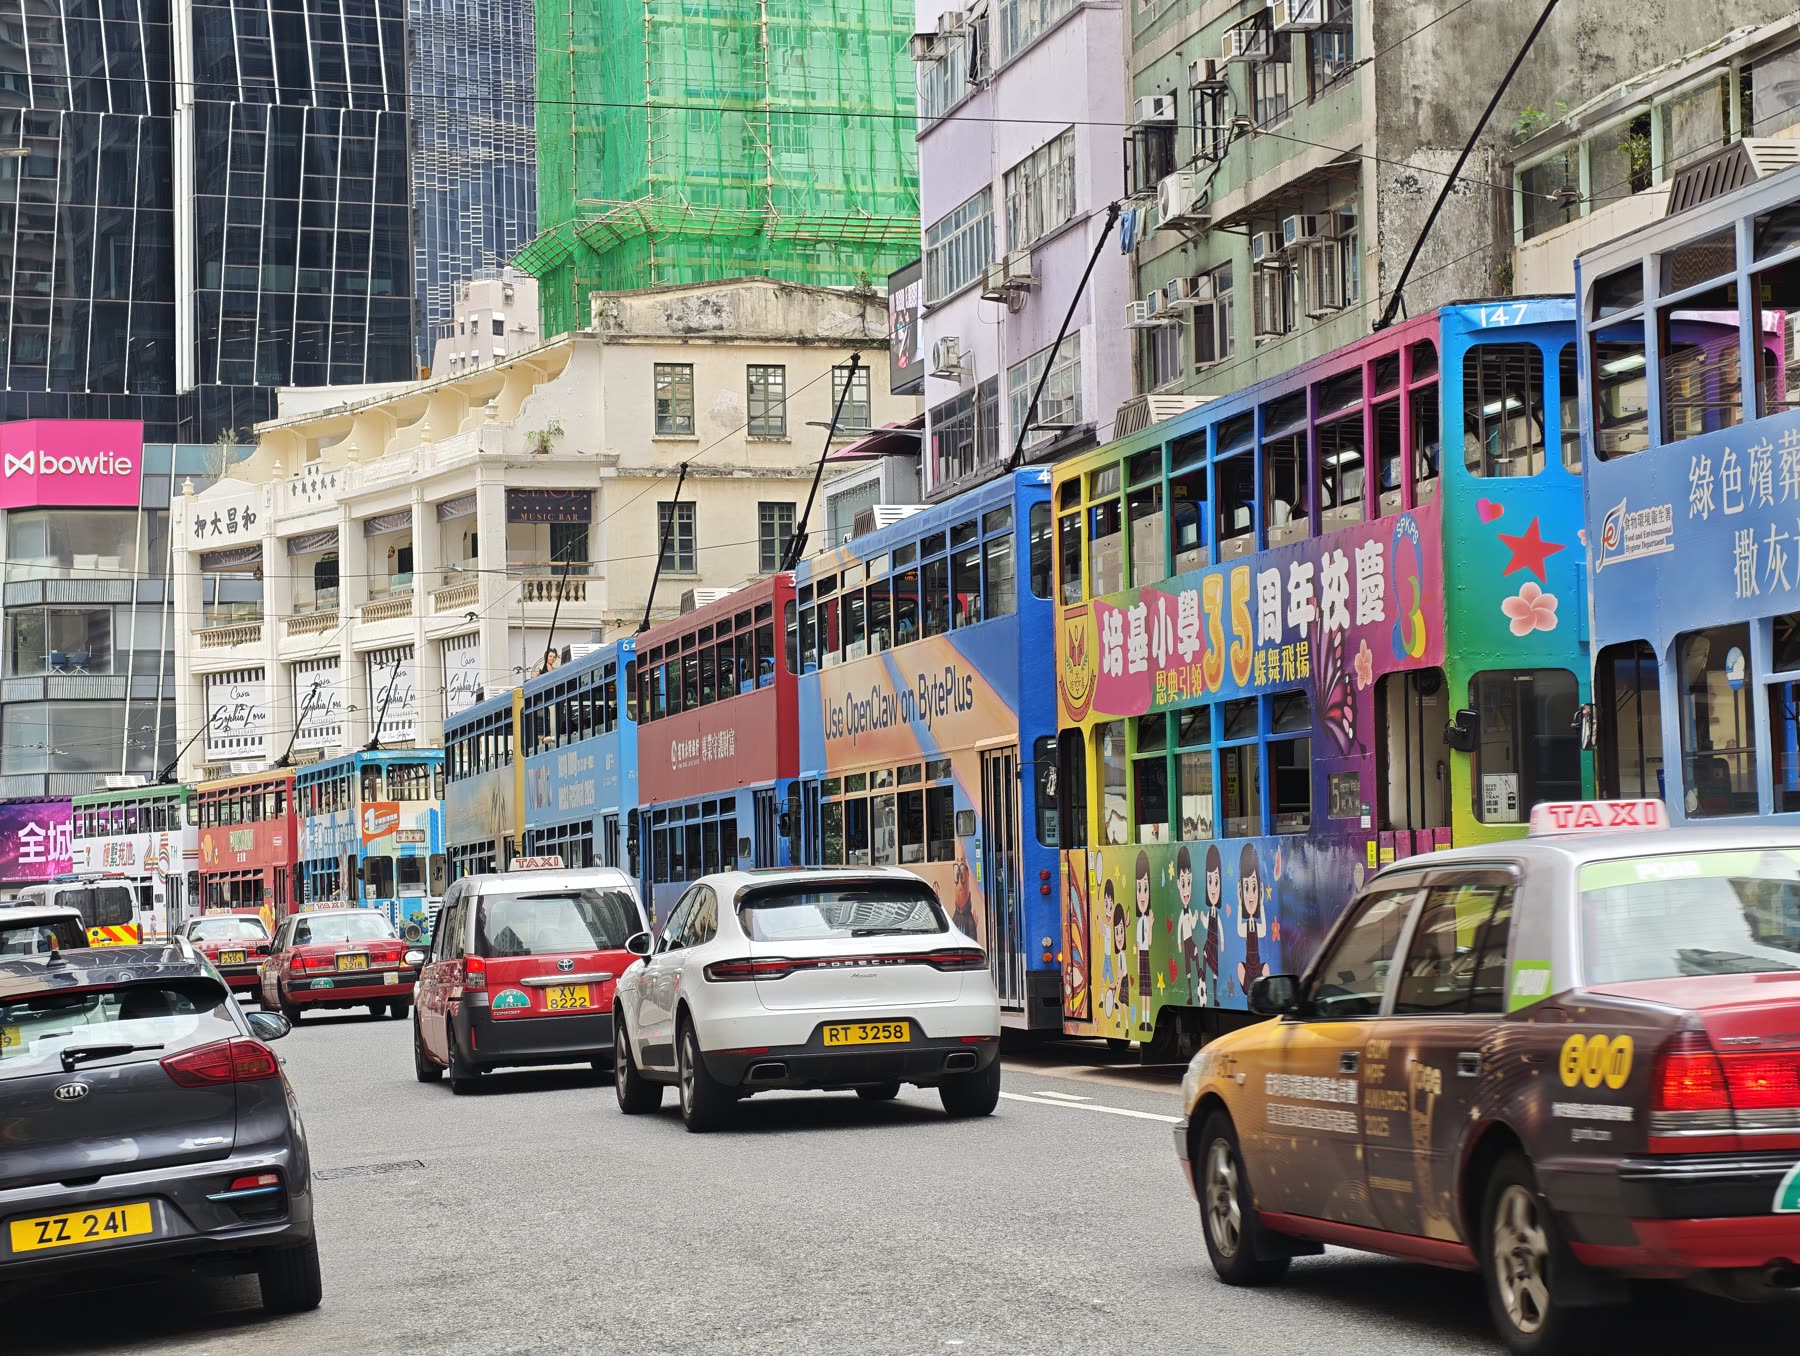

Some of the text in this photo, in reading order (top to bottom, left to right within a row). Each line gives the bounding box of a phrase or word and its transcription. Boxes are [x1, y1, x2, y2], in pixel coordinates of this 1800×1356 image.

[1480, 304, 1528, 328] 147
[39, 450, 132, 475] bowtie
[1625, 533, 1635, 543] Food
[1644, 525, 1672, 539] Environmental
[1626, 538, 1665, 555] Hygiene Department
[461, 651, 476, 667] Casa
[1254, 641, 1310, 687] 蝶舞飛揚
[1156, 662, 1202, 706] 恩典引領
[230, 686, 250, 700] Casa
[824, 664, 973, 746] Use OpenClaw on BytePlus
[213, 704, 245, 731] Sophia
[1548, 802, 1658, 829] TAXI
[516, 857, 559, 868] TAXI
[316, 902, 344, 910] TAXI
[343, 962, 363, 970] 3218
[818, 958, 906, 968] PORSCHE
[559, 987, 576, 998] XV
[550, 997, 587, 1008] 8222
[829, 1025, 904, 1042] RT 3258
[59, 1086, 84, 1098] KIA
[35, 1210, 128, 1243] ZZ 241
